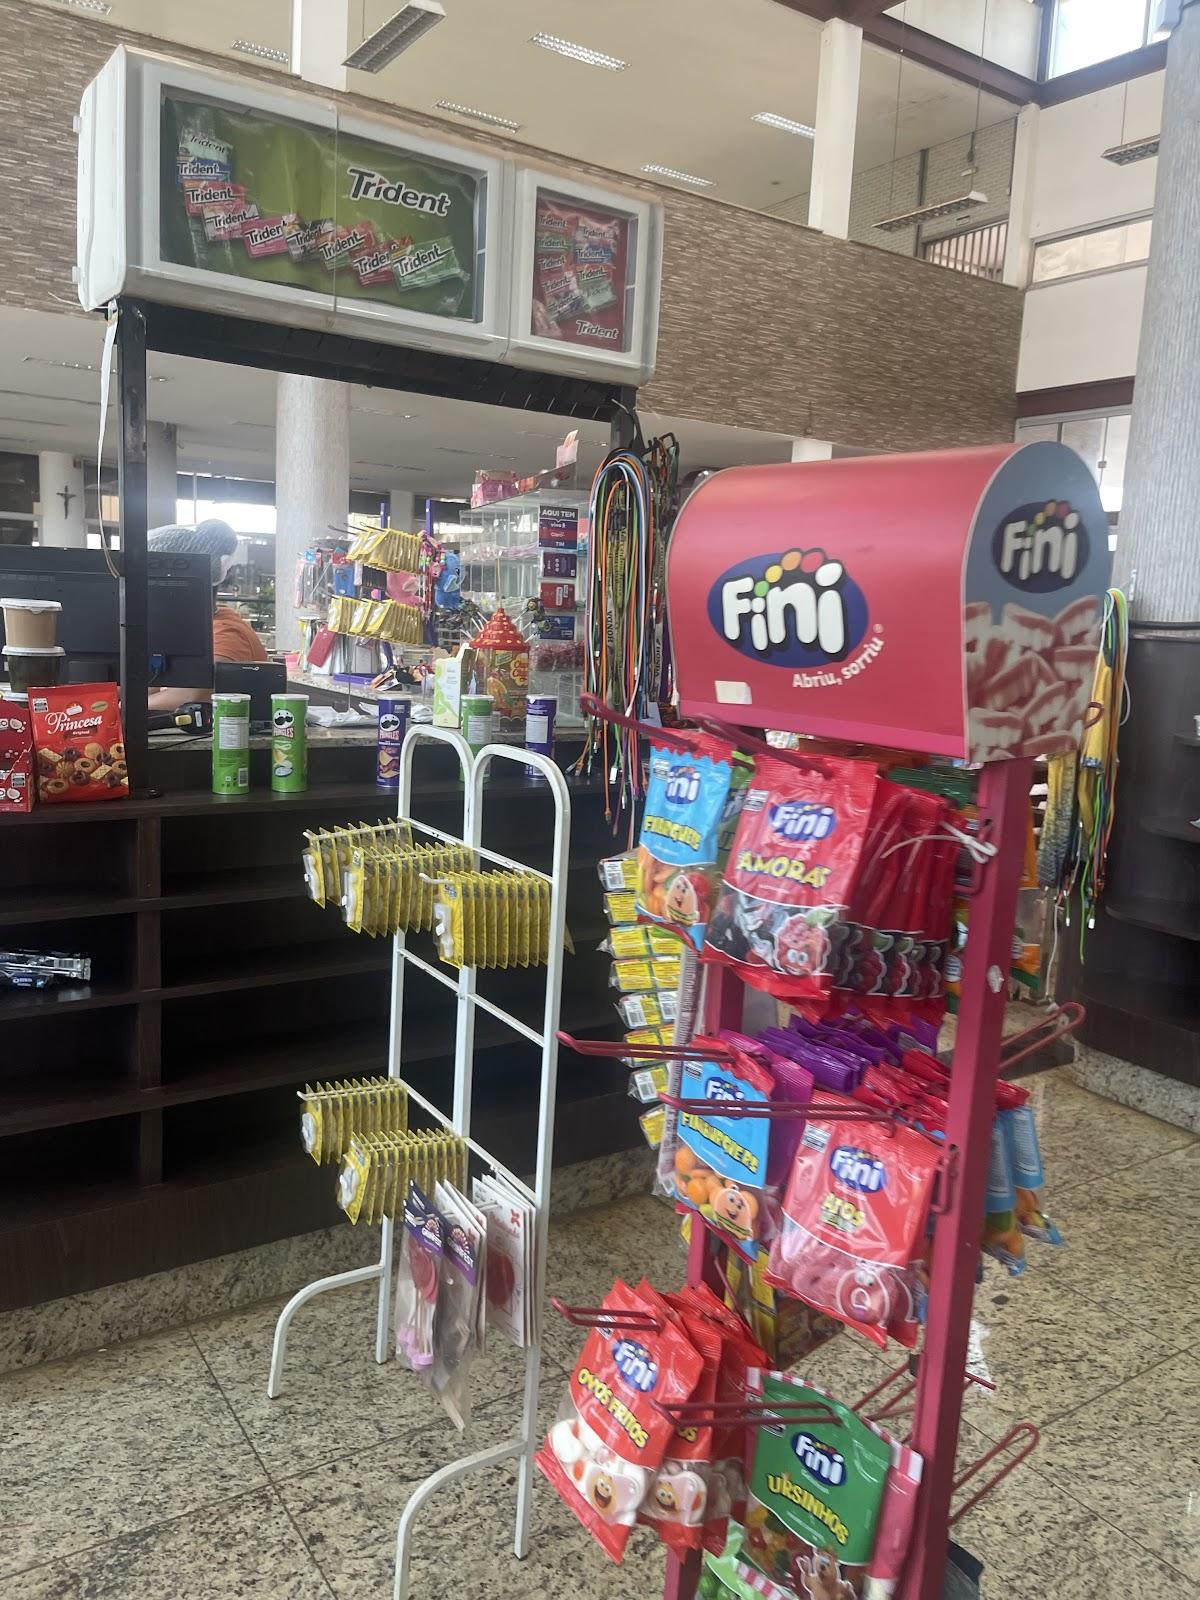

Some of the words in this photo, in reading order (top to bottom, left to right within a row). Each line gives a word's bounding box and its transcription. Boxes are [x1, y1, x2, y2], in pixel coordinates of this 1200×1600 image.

[179, 162, 221, 175] Trident
[188, 188, 233, 202] Trident
[348, 167, 451, 216] Trident
[212, 211, 248, 227] Trident
[320, 231, 364, 259] Trident
[396, 246, 443, 275] Trident
[576, 320, 619, 339] Trident
[541, 509, 559, 517] AQUI
[561, 511, 576, 519] TEM
[1000, 510, 1081, 581] Fini
[722, 561, 845, 654] Fini
[606, 610, 614, 643] HONDA
[792, 670, 843, 688] Abriu,
[841, 637, 885, 680] sorriu
[44, 711, 103, 734] Princesa
[667, 771, 700, 802] ini
[771, 804, 834, 836] Fini
[736, 850, 833, 889] AMORAS
[830, 1147, 883, 1191] Fini
[615, 1341, 657, 1391] Fini
[578, 1367, 613, 1405] OVOS
[608, 1395, 650, 1449] FRITOS
[795, 1433, 844, 1485] Fini
[766, 1472, 849, 1546] URSINHOS
